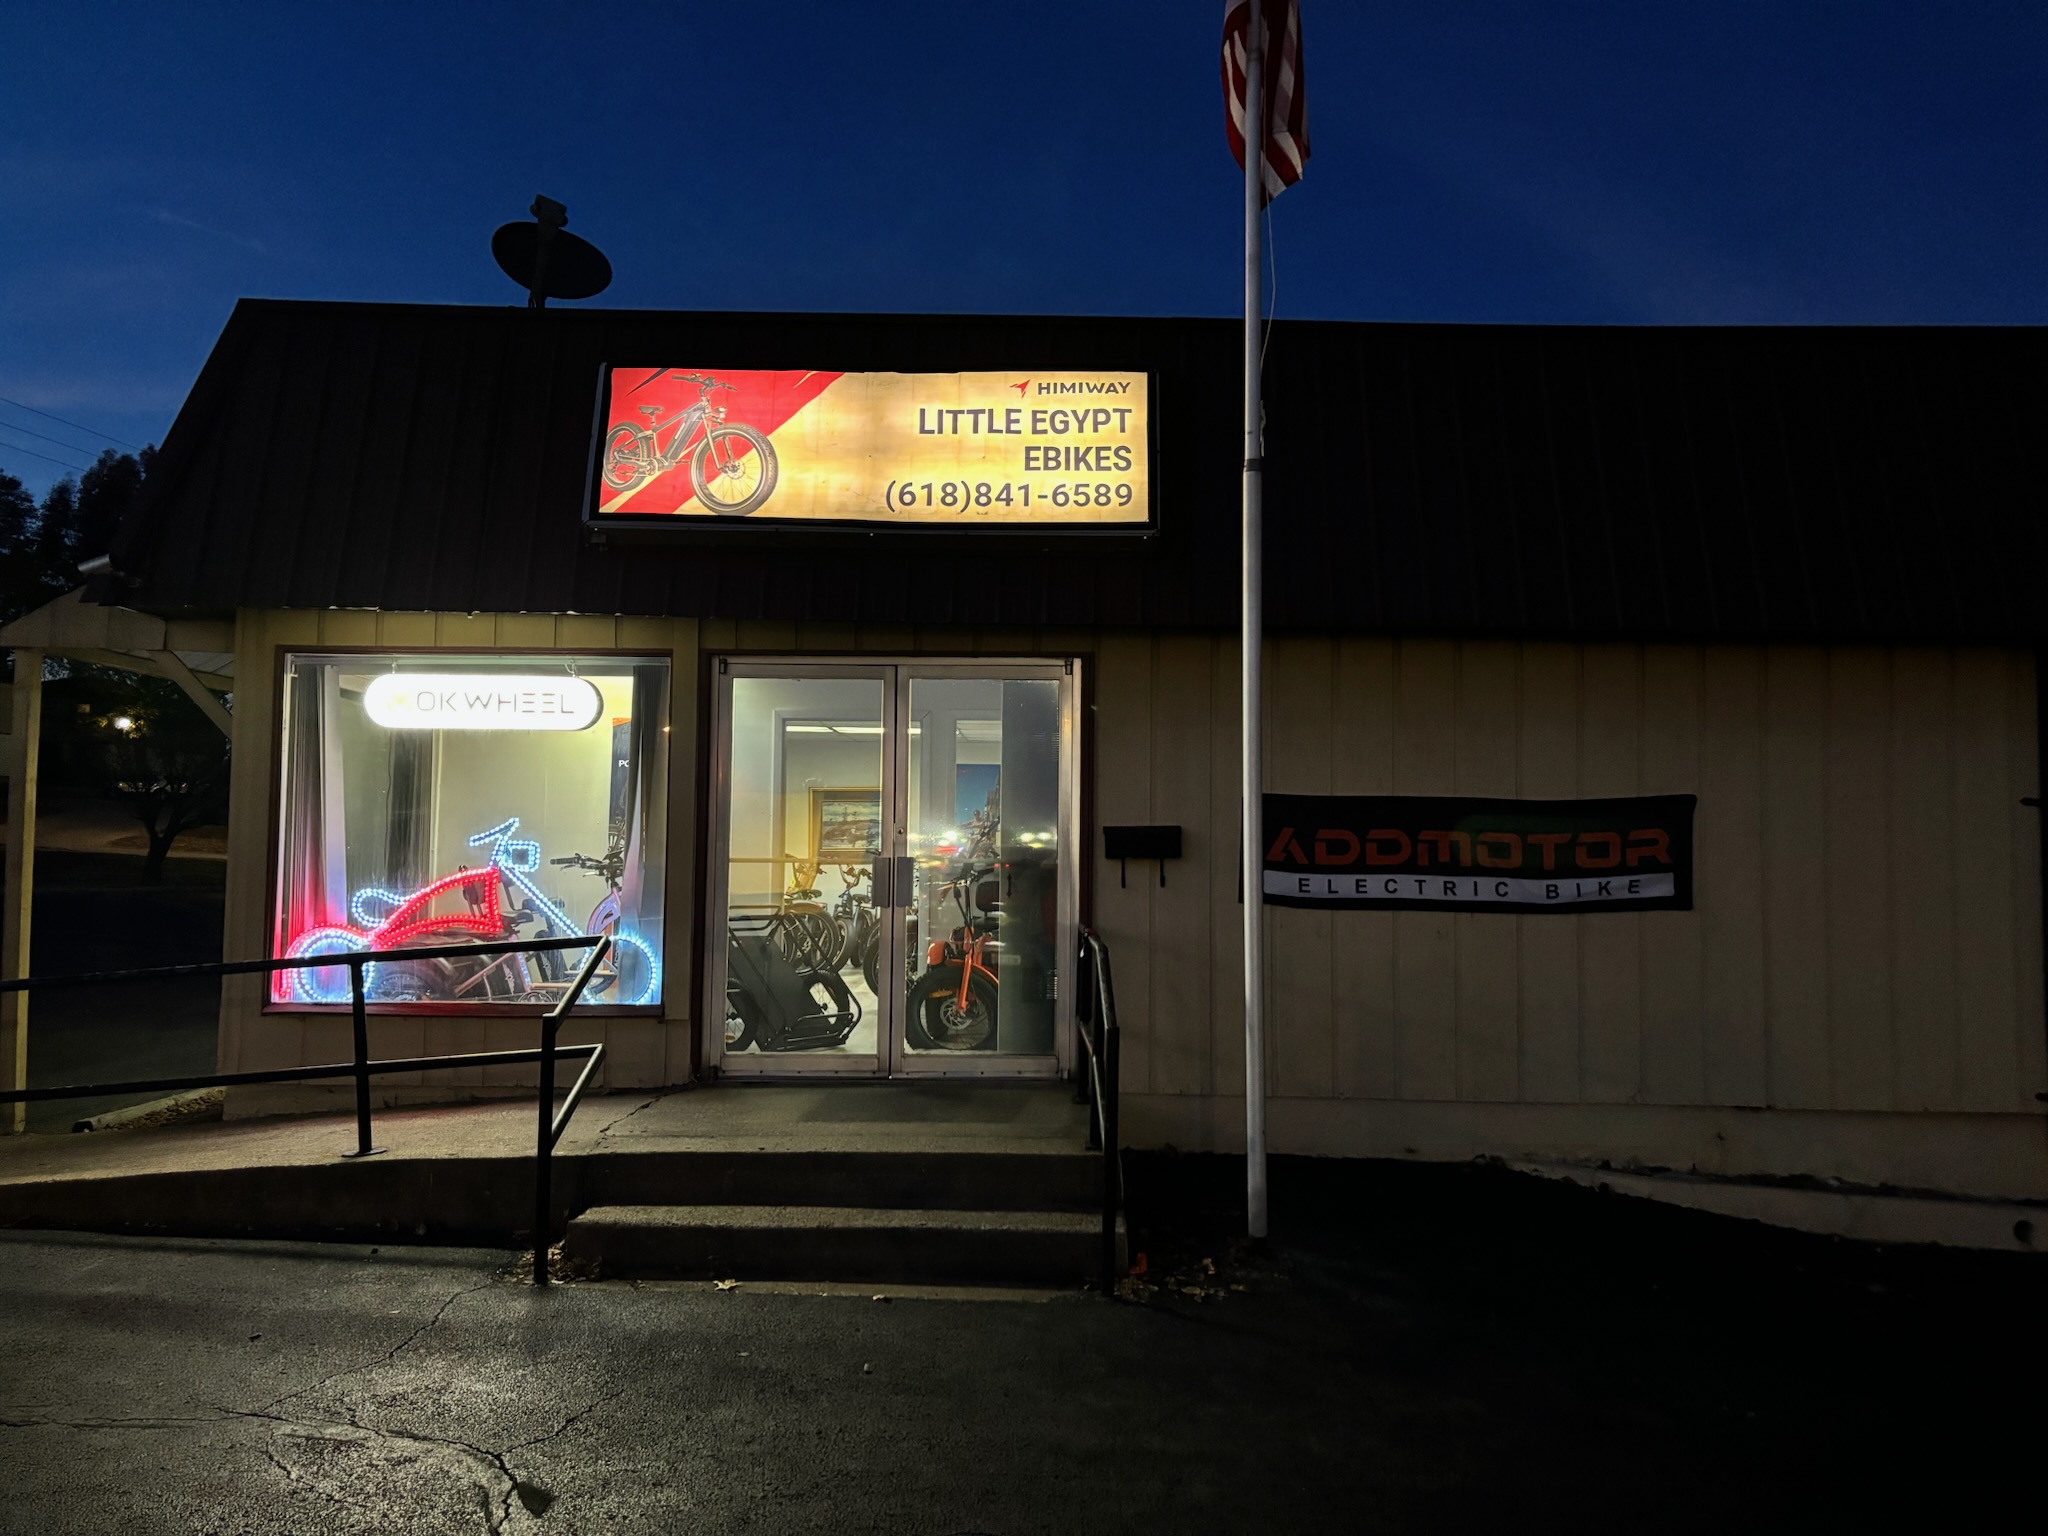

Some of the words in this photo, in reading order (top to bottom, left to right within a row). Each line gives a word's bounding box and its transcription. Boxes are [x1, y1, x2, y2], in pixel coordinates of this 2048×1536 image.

[1037, 381, 1131, 396] HIMIWAY
[919, 407, 1022, 435] LITTLE
[1031, 407, 1133, 435] EGYPT
[1024, 445, 1133, 472] EBIKES
[885, 480, 1133, 513] (618)841-6589
[1264, 826, 1673, 871] ADDMOTOR
[1298, 877, 1509, 898] ELECTRIC
[1545, 878, 1642, 900] BIKE
